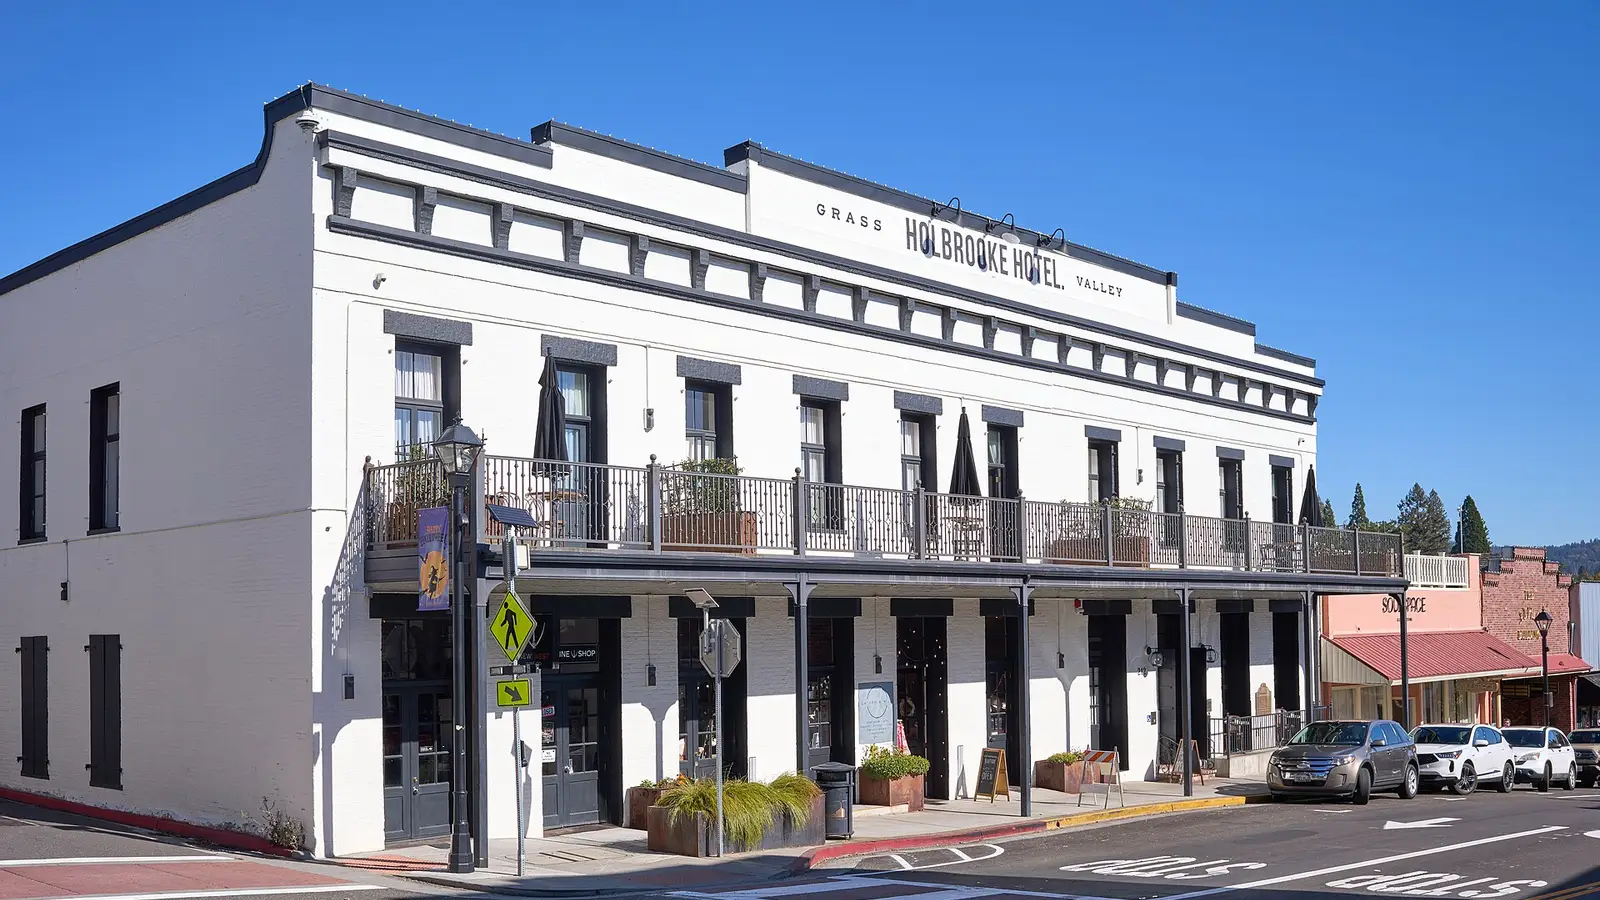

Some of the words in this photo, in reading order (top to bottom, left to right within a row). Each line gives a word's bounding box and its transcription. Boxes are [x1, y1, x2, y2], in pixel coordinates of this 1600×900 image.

[816, 203, 882, 231] GRASS
[905, 217, 1009, 276] HOLBROOKE
[1013, 248, 1065, 290] HOTEL.
[1076, 275, 1123, 297] VALLEY
[558, 650, 571, 658] INE
[577, 649, 596, 658] SHOP
[1059, 855, 1267, 880] STOP
[1325, 870, 1548, 898] STOP
